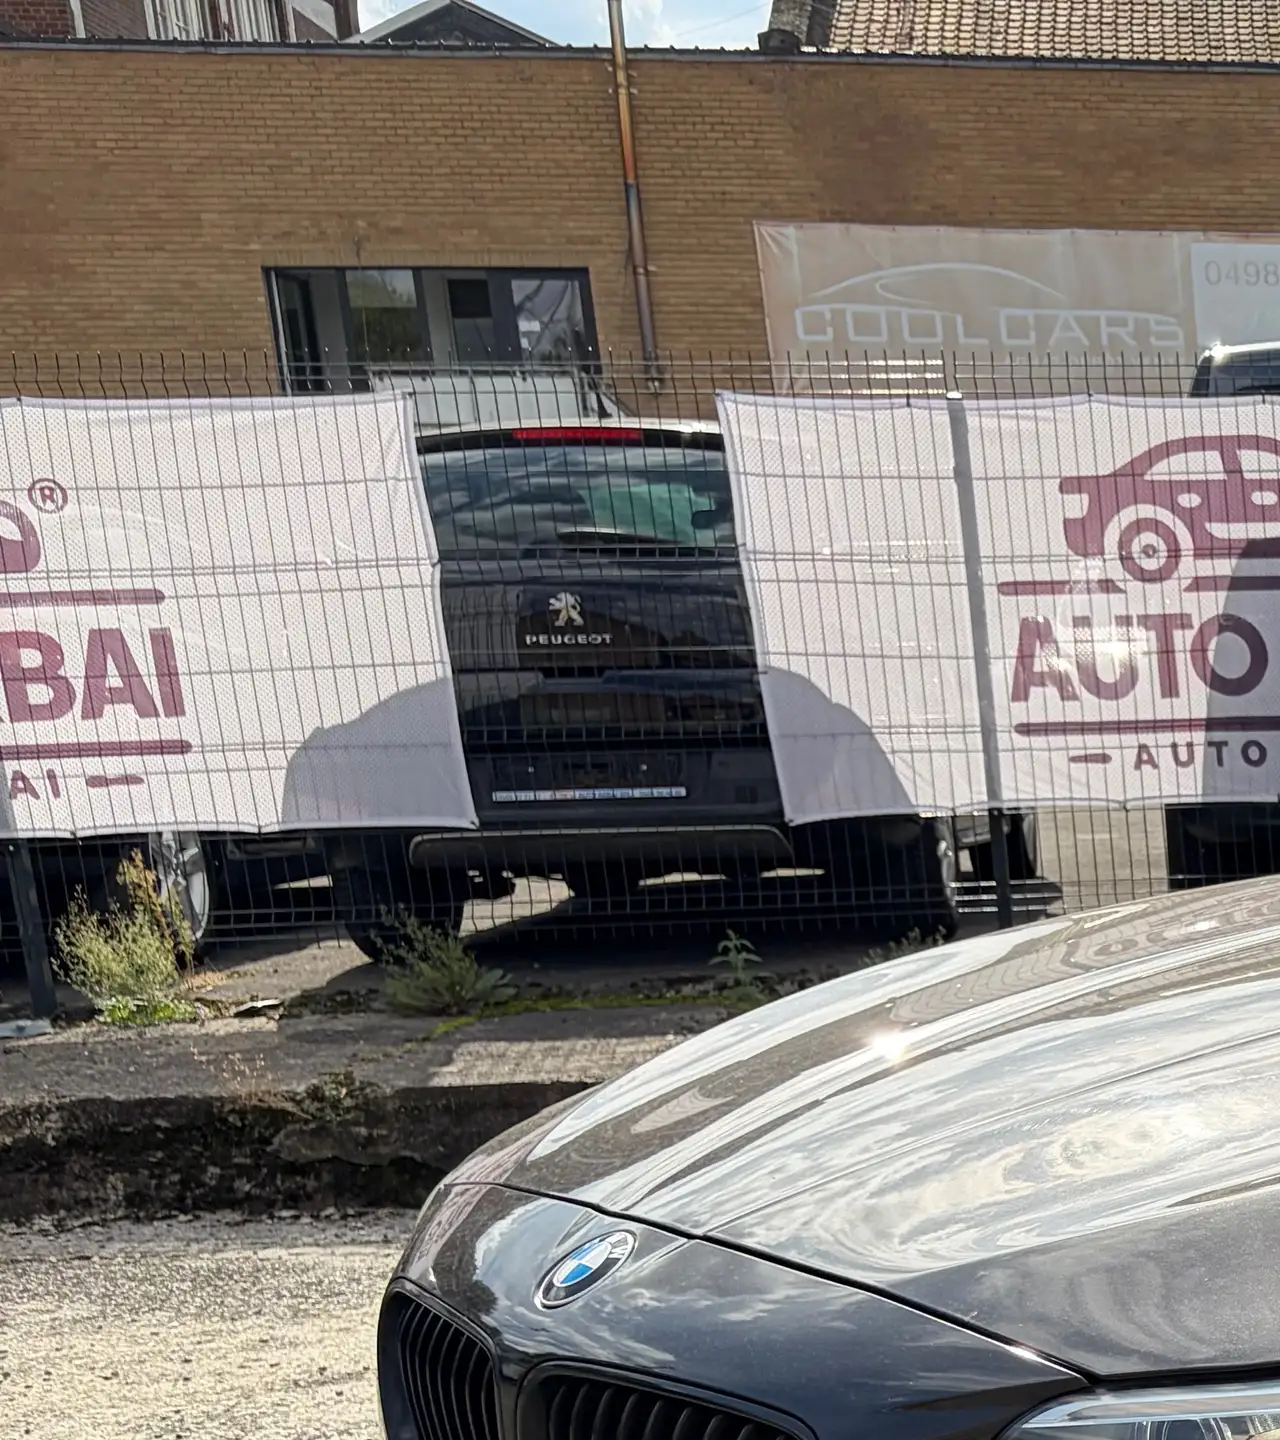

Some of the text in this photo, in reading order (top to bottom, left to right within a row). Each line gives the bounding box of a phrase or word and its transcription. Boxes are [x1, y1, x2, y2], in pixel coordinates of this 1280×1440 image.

[525, 633, 613, 646] PEUGEOT
[1010, 612, 1269, 703] AUTO
[1134, 739, 1268, 769] AUTO
